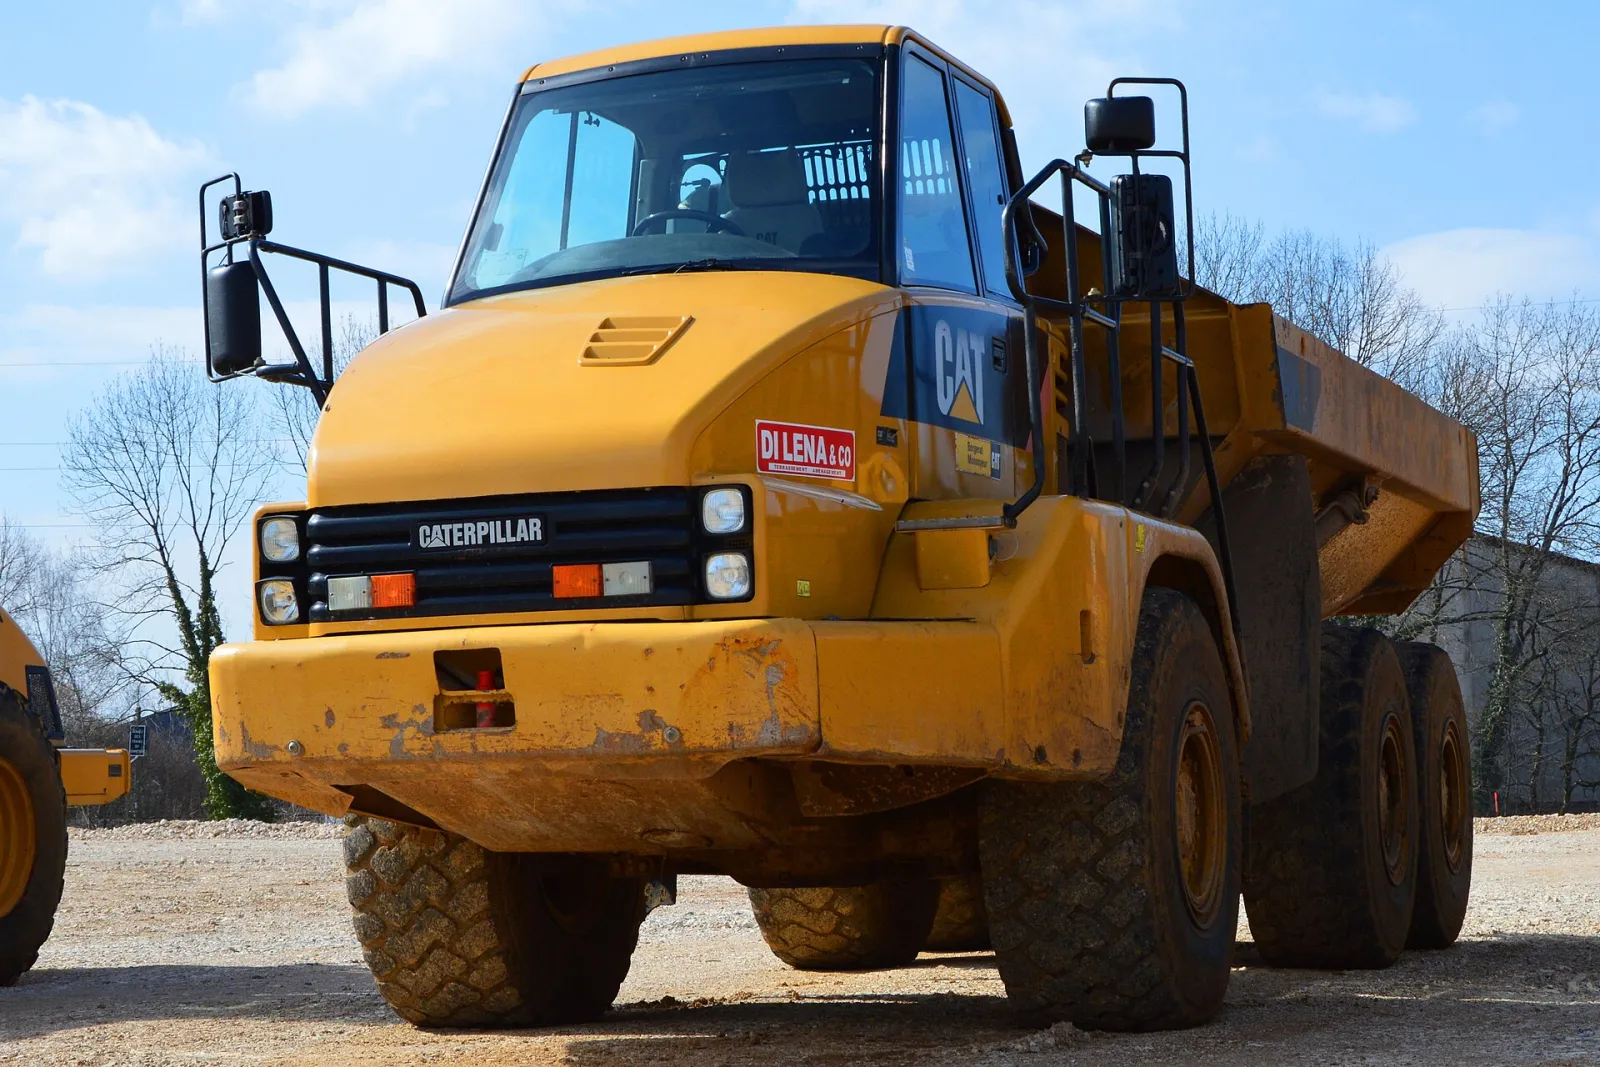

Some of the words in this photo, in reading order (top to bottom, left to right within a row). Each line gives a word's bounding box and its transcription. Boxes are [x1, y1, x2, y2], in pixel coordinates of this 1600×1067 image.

[935, 319, 985, 425] CAT
[761, 430, 779, 460] DI
[782, 431, 828, 465] LENA
[829, 444, 837, 466] &
[838, 446, 851, 467] CO
[418, 517, 542, 549] CATERPILLAR
